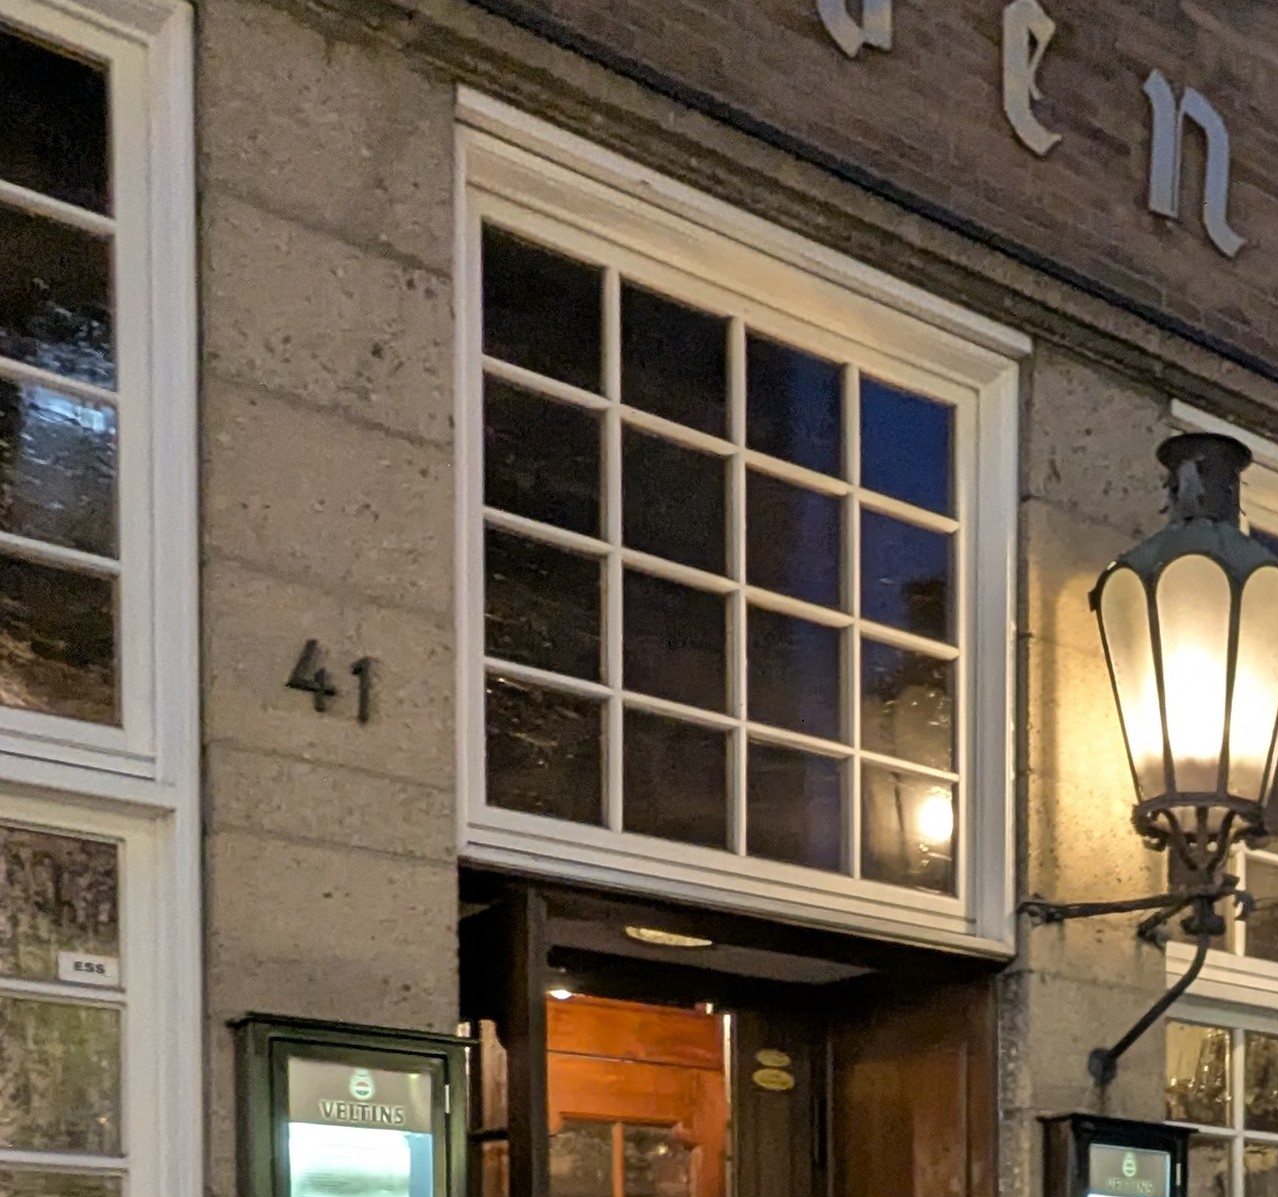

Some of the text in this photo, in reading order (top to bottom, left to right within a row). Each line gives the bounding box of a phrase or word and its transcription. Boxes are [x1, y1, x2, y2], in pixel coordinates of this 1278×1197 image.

[286, 640, 376, 726] 41
[73, 960, 106, 975] ESS
[319, 1099, 406, 1126] VELTINS
